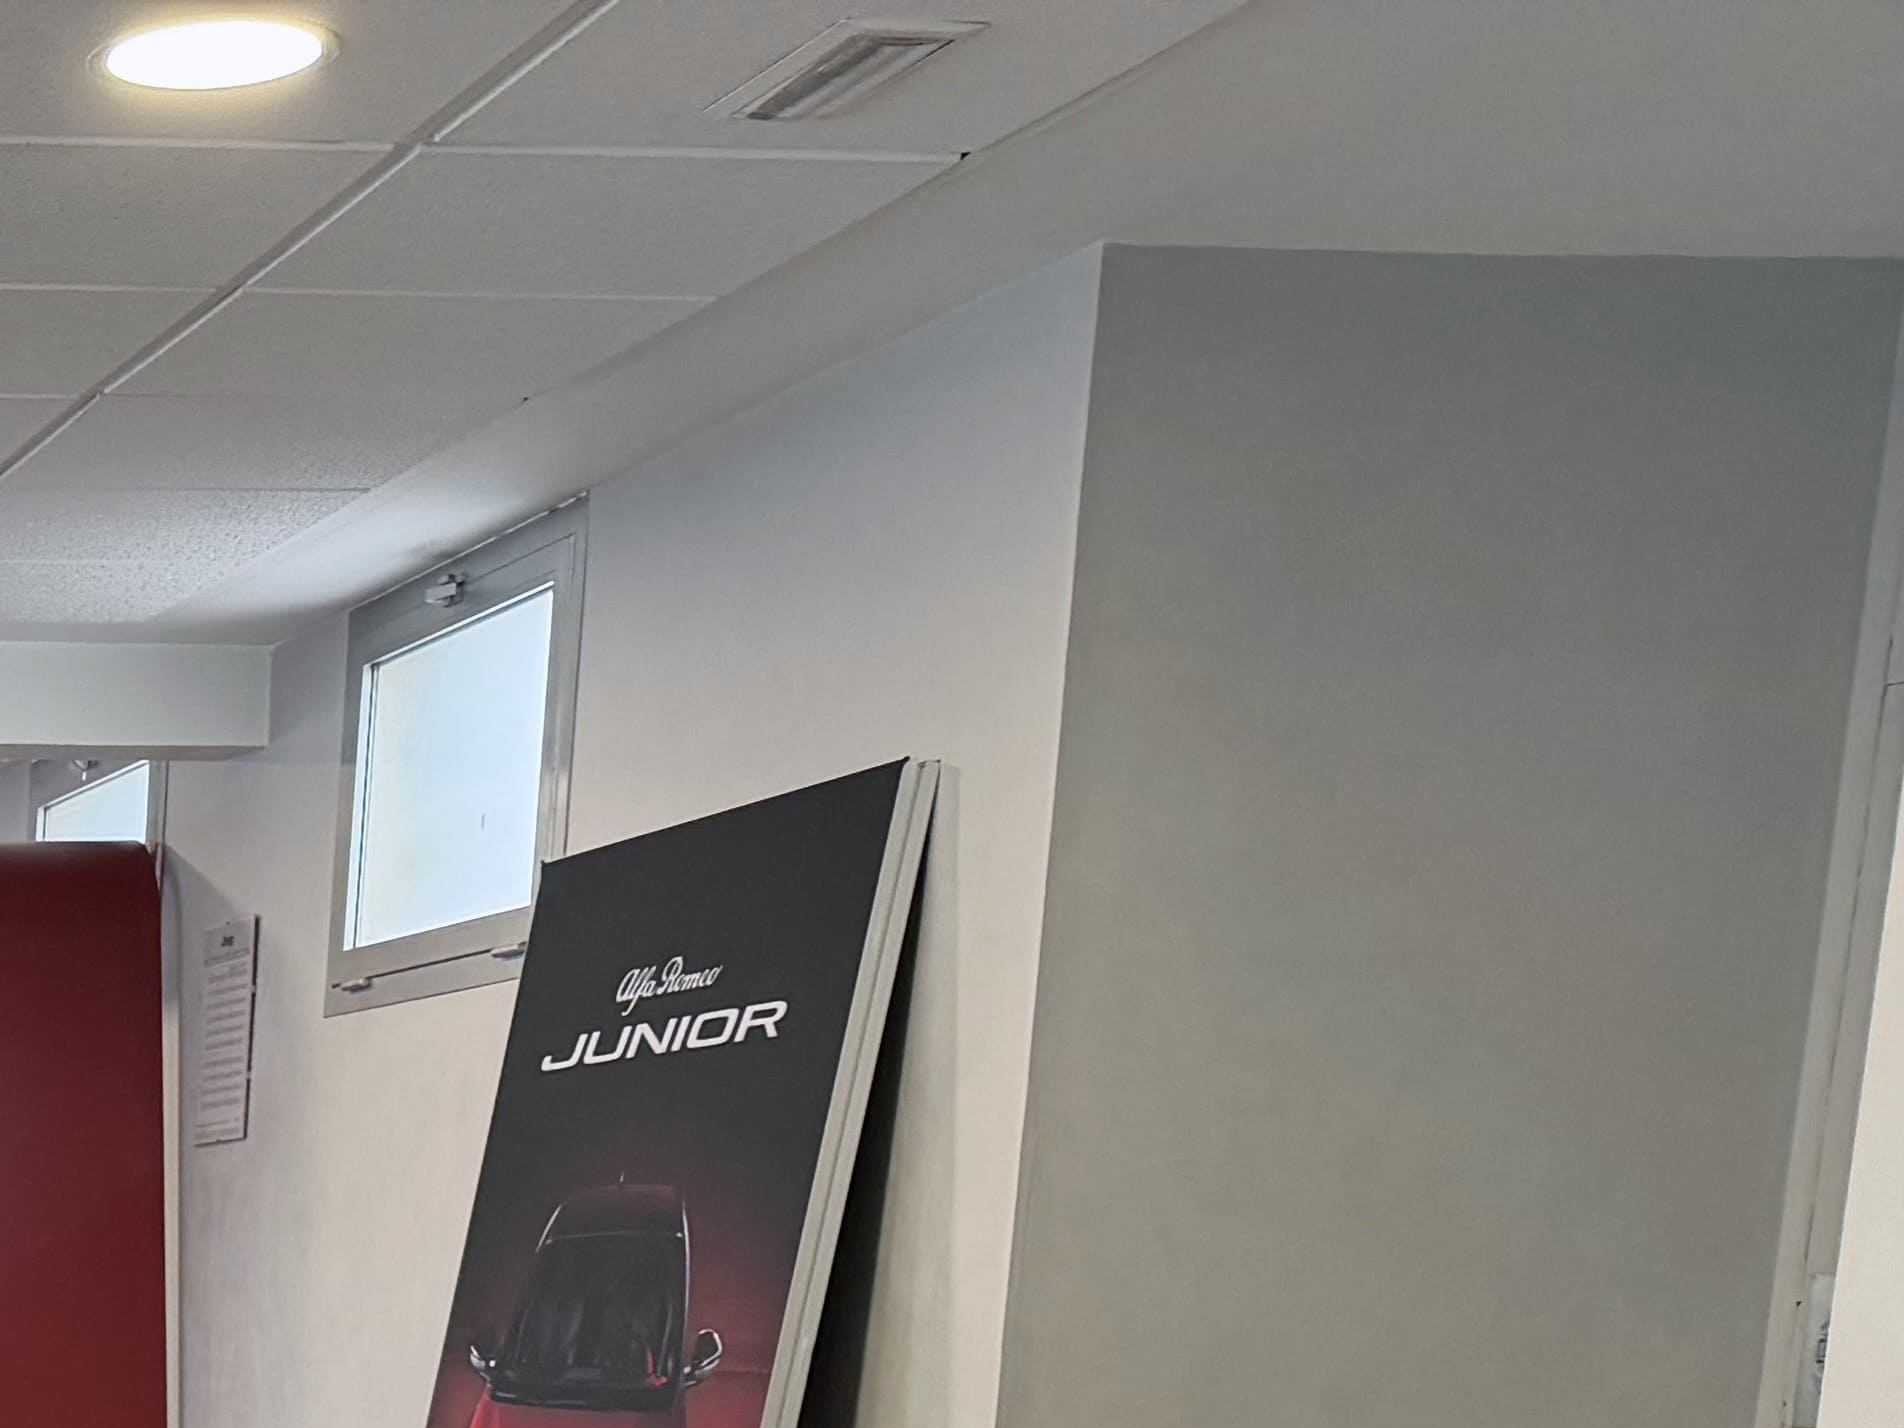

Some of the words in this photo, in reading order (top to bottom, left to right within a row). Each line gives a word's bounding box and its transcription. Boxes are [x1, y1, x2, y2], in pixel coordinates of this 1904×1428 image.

[615, 965, 657, 1016] Alfa
[657, 955, 723, 995] Romeo
[541, 1000, 788, 1072] JUNIOR
